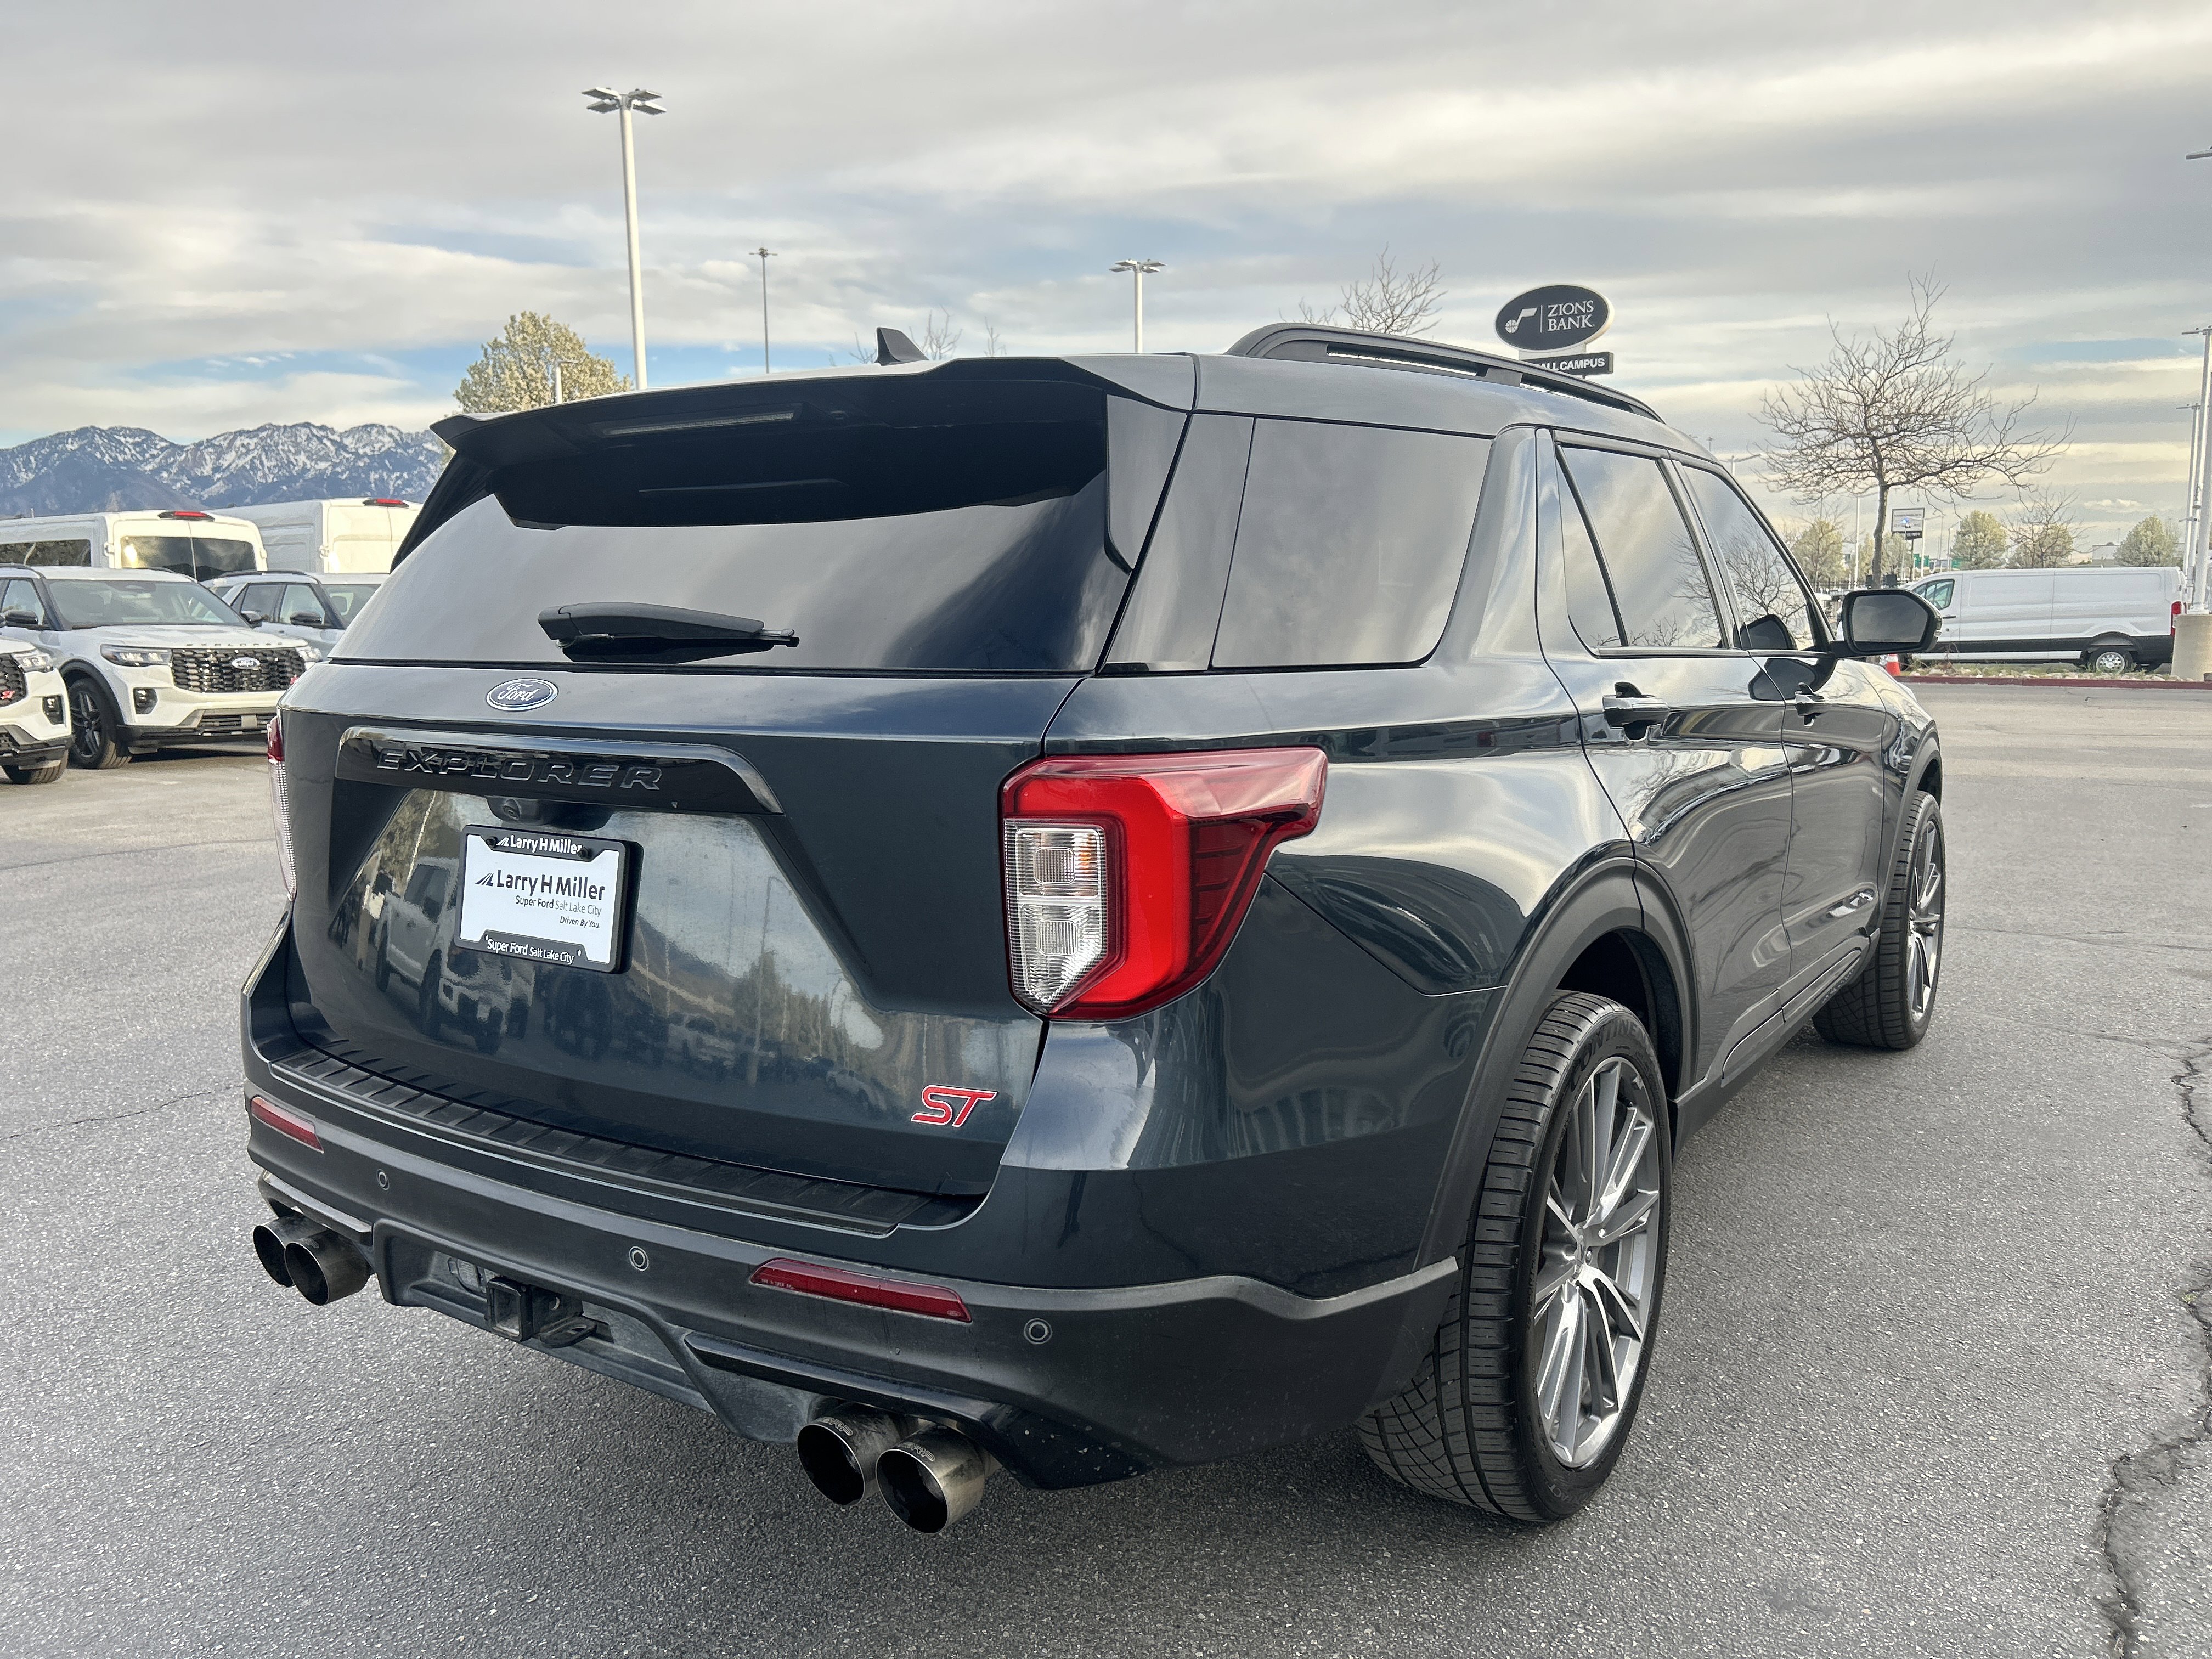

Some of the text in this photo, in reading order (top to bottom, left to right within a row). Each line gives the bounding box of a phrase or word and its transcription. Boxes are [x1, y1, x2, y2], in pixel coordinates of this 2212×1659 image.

[1548, 300, 1594, 317] ZIONS
[1559, 357, 1605, 370] CAMPUS
[497, 682, 540, 701] Ford
[377, 747, 662, 791] EXPLORER
[510, 834, 583, 855] Larry H Miller
[496, 869, 606, 901] Larry H Miller
[515, 895, 602, 917] Super Ford Salt Lake City
[560, 916, 579, 926] Driven
[580, 918, 588, 928] By
[487, 938, 574, 965] Super Ford Salt Lake City
[911, 1084, 998, 1127] ST
